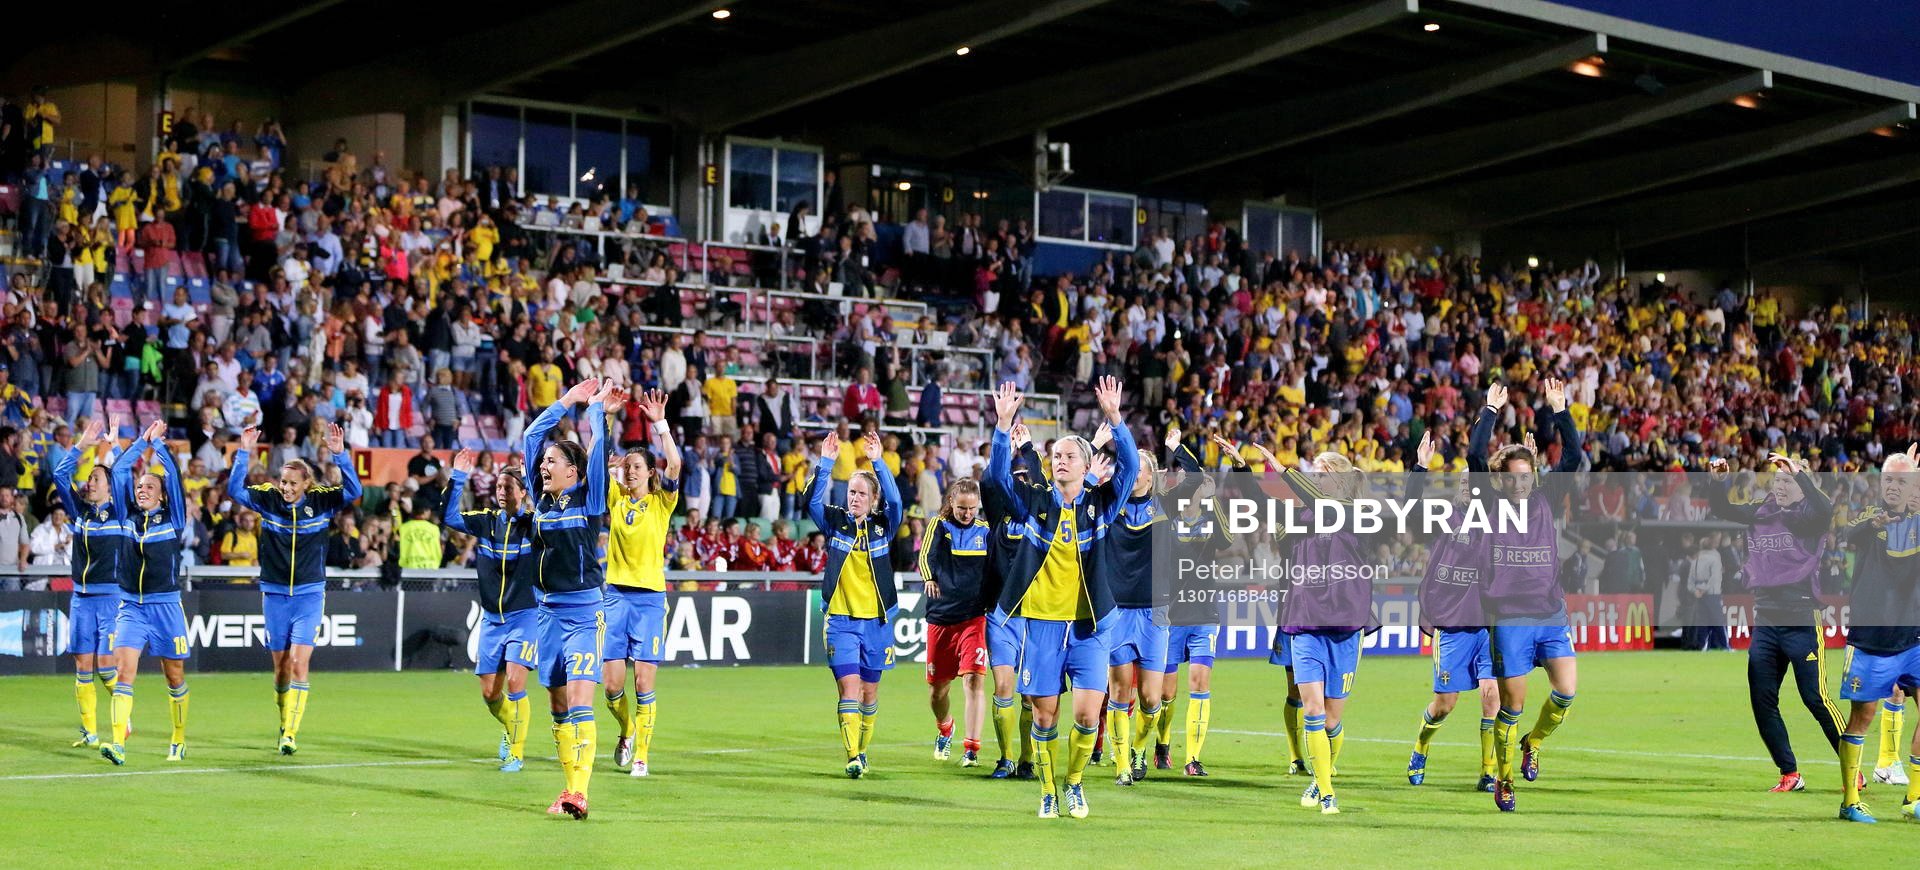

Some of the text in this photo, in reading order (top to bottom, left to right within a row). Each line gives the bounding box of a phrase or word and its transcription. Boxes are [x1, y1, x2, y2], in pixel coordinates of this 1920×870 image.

[163, 113, 172, 132] E
[707, 166, 716, 183] E
[358, 454, 369, 475] L
[1060, 519, 1073, 543] 5
[1507, 550, 1552, 563] RESPECT
[173, 635, 189, 655] 18
[520, 641, 535, 662] 16
[652, 636, 660, 656] 8
[572, 652, 596, 676] 22
[1341, 672, 1355, 695] 10
